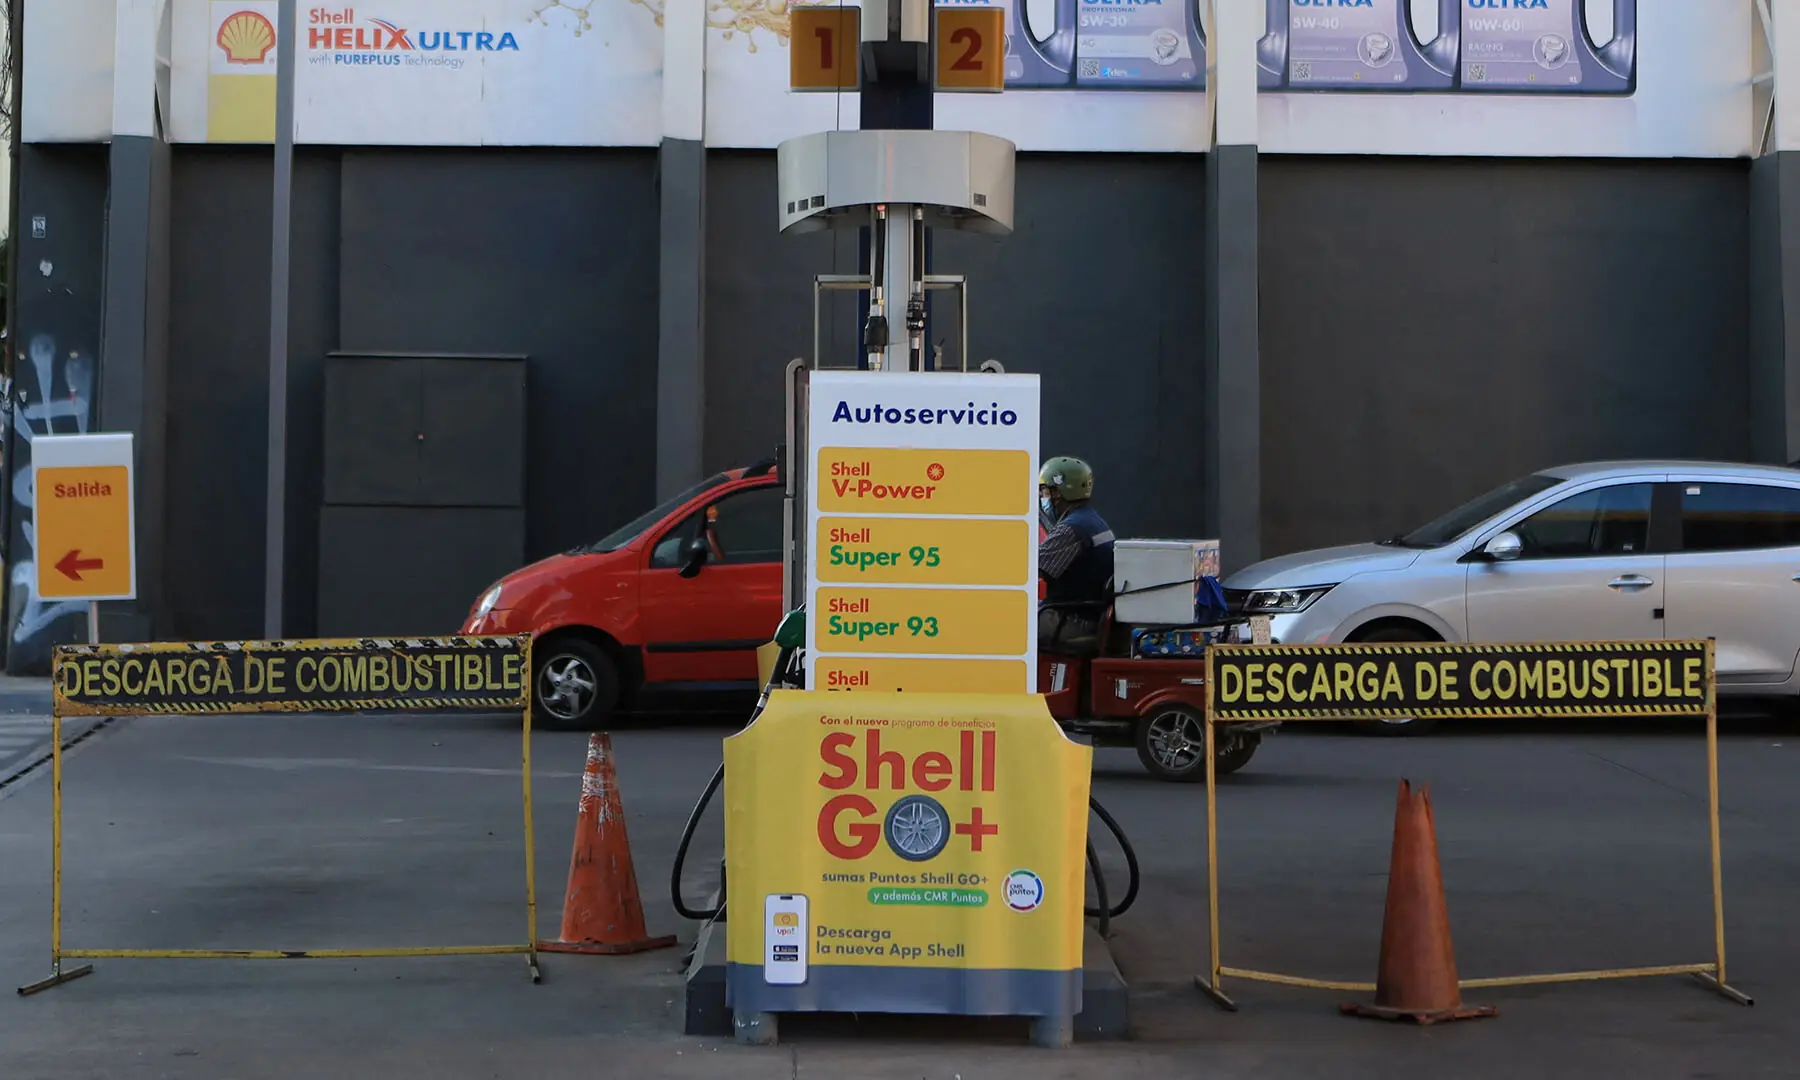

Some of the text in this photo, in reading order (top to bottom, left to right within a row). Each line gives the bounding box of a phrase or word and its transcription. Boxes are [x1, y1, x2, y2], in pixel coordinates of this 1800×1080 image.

[309, 8, 354, 25] Shell
[1080, 16, 1128, 28] 5W-30
[1292, 16, 1340, 30] 5W-40
[1468, 18, 1521, 32] 10W-60
[308, 27, 520, 51] HELIX ULTRA
[814, 27, 833, 70] 1
[948, 27, 983, 71] 2
[309, 54, 465, 69] with PUREPLUS Technology
[832, 400, 1018, 426] Autoservicio
[831, 461, 870, 477] Shell
[54, 482, 112, 499] Salida
[832, 478, 936, 500] V-Power
[830, 528, 870, 544] Shell
[830, 545, 941, 572] Super 95
[828, 598, 869, 613] Shell
[828, 615, 939, 641] Super 93
[62, 654, 521, 697] DESCARGA DE COMBUSTIBLE
[828, 671, 869, 687] Shell
[1221, 657, 1703, 703] DESCARGA DE COMBUSTIBLE
[820, 715, 996, 729] Con el nuevo programa de beneficios
[818, 729, 996, 792] Shell
[822, 872, 989, 885] sumas Puntos Shell GO+
[873, 890, 983, 903] y además CMR Puntos
[816, 925, 891, 942] Descarga
[816, 941, 965, 960] la nueva App Shell
